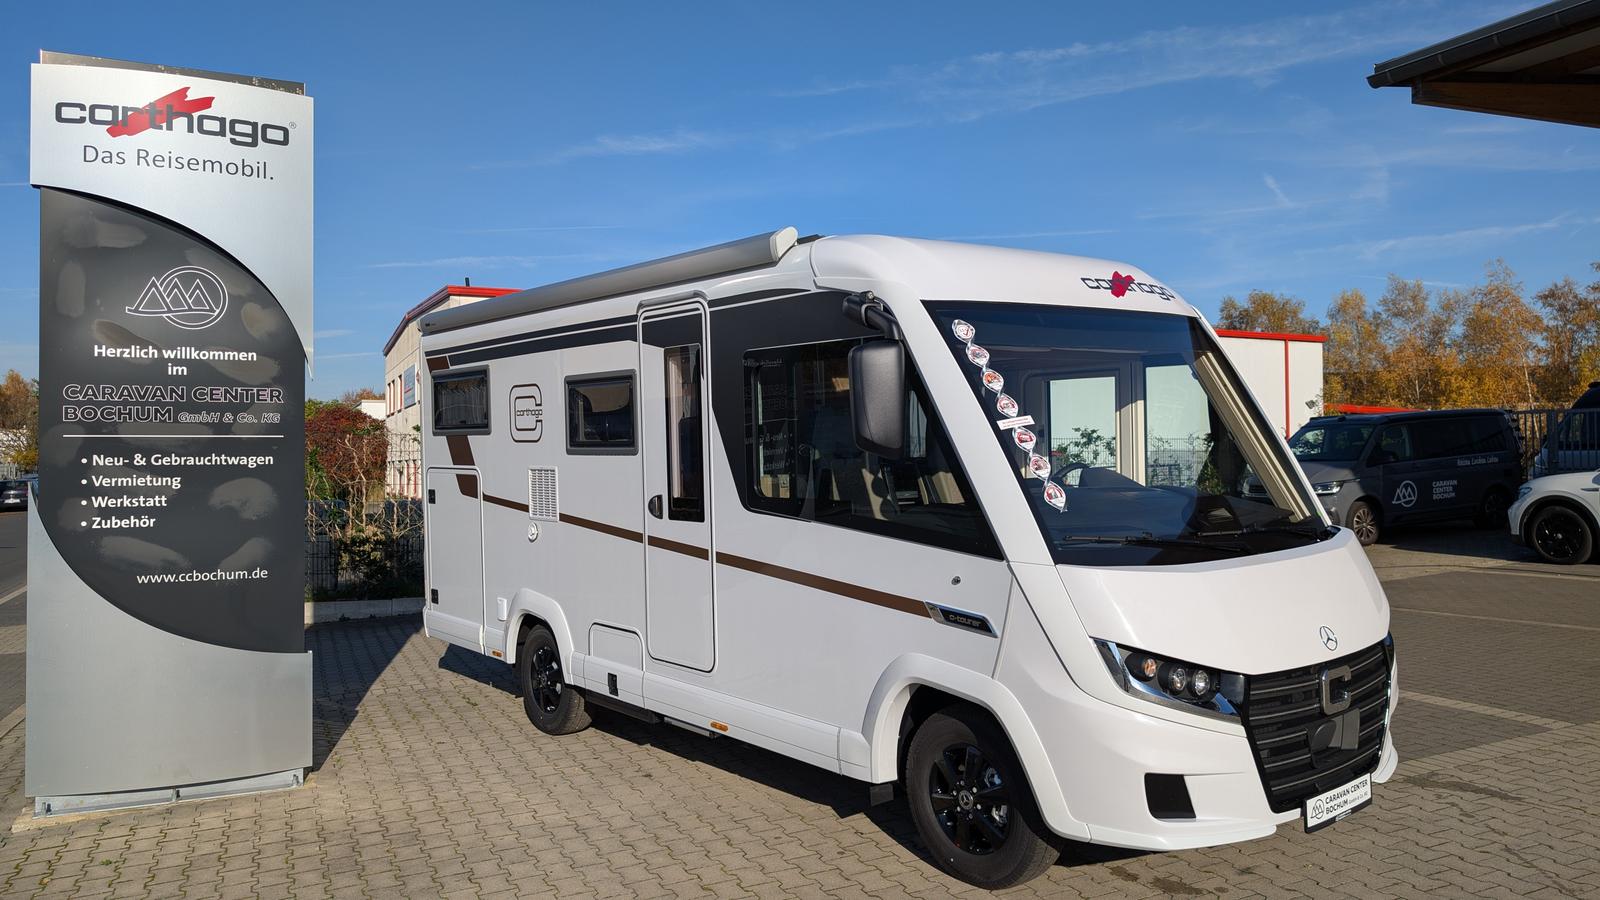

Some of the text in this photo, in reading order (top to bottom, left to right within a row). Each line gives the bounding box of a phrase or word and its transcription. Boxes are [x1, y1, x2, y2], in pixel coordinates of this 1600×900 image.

[55, 101, 290, 148] carthago
[83, 145, 275, 181] Das Reisemobil.
[93, 345, 257, 361] Herzlich willkommen
[167, 363, 188, 376] im
[62, 384, 284, 404] CARAVAN CENTER
[62, 405, 281, 423] BOCHUM GmbH & Co. KG
[92, 453, 274, 469] Neu- & Gebrauchtwagen
[92, 475, 182, 489] Vermietung
[91, 494, 168, 508] Werkstatt
[91, 516, 156, 529] Zubehör
[136, 568, 269, 584] www.ccbochum.de
[1325, 787, 1351, 804] CARAVAN
[1350, 779, 1368, 794] CENTER
[1325, 799, 1349, 815] BOCHUM
